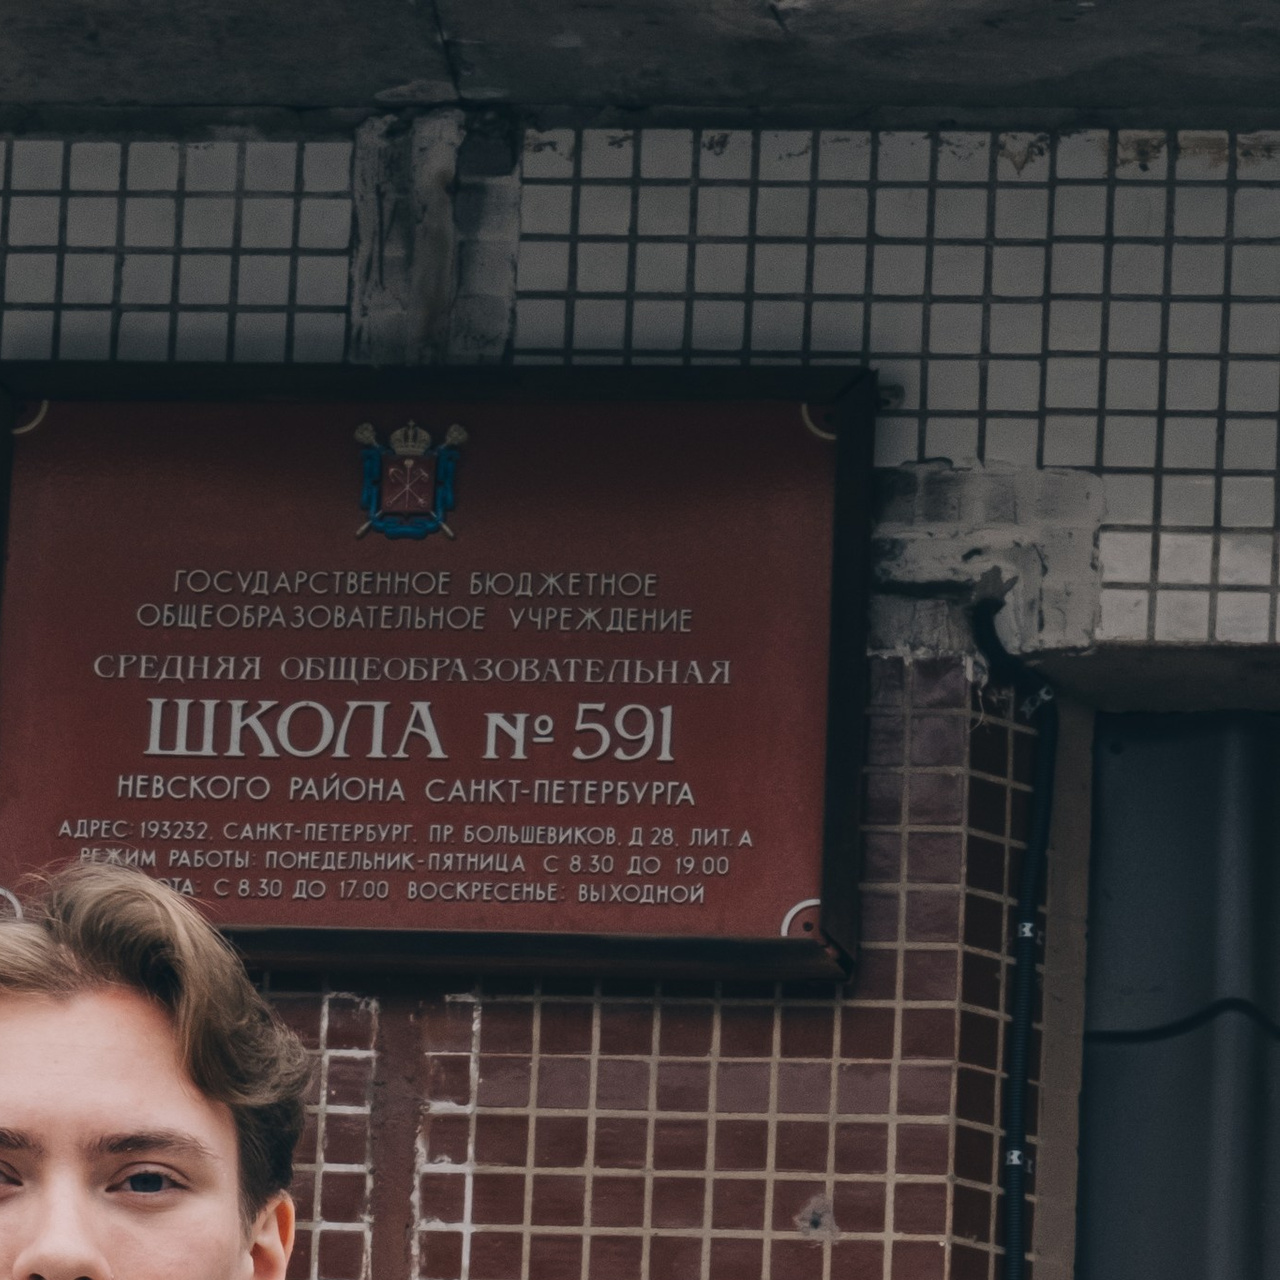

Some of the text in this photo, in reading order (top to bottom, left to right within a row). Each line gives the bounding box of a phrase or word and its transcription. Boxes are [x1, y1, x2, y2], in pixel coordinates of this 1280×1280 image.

[173, 569, 657, 597] ГОСУДАРСТВЕННОЕ БЮДЖЕТНОЕ
[136, 603, 693, 633] ОБЩЕОБРАЗОВАТЕЛЬНОЕ УЧРЕЖДЕНИЕ
[93, 654, 732, 686] СРЕДНЯЯ ОБЩЕОБРАЗОВАТЕЛЬНАЯ
[143, 697, 450, 760] ШКОЛА
[571, 702, 675, 762] 591
[117, 772, 696, 807] НЕВСКОГО РАЙОНА САНКТ-ПЕТЕРБУРГА
[58, 819, 134, 840] АДРЕС:
[429, 824, 455, 844] ПР.
[738, 830, 754, 848] А
[80, 847, 730, 876] РЕЖИМ РАБОТЫ: ПОНЕДЕЛЬНИК-ПЯТНИЦА С 8.30 ДО 19.00
[214, 878, 230, 897] С
[237, 878, 283, 898] 8.30
[292, 879, 327, 899] ДО
[340, 880, 389, 899] 17.00
[407, 881, 566, 902] ВОСКРЕСЕНЬЕ:
[578, 882, 705, 904] ВЫХОДНОЙ
